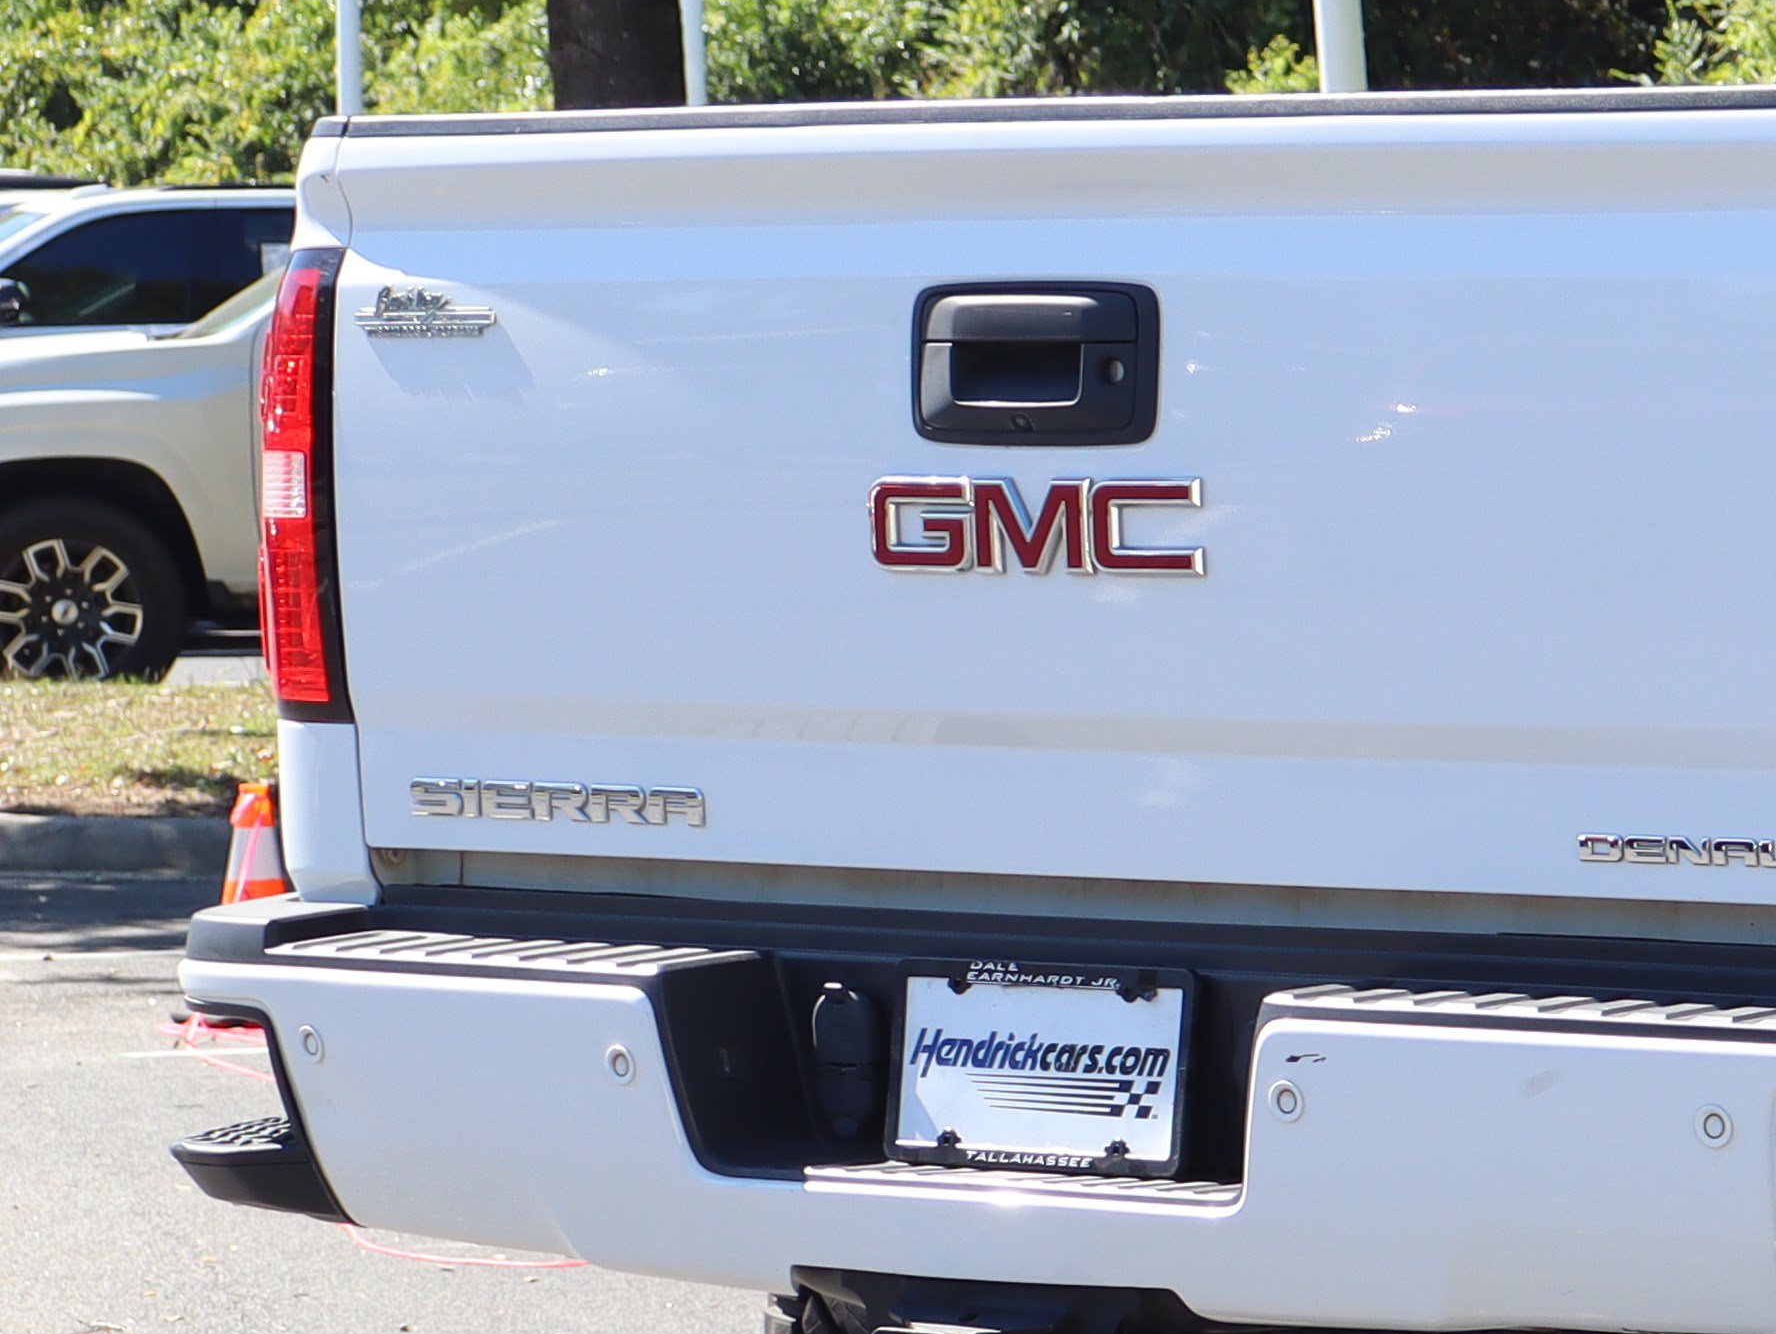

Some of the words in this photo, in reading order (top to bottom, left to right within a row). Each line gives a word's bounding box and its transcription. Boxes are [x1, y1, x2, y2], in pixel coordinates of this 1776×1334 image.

[868, 473, 1204, 577] GMC
[408, 775, 707, 828] SIERRA
[966, 970, 1085, 986] EARNHARDT
[969, 960, 1019, 972] DALE
[909, 1027, 1171, 1078] Hendrickcars.com
[966, 1150, 1093, 1168] TALLAHASSEE
